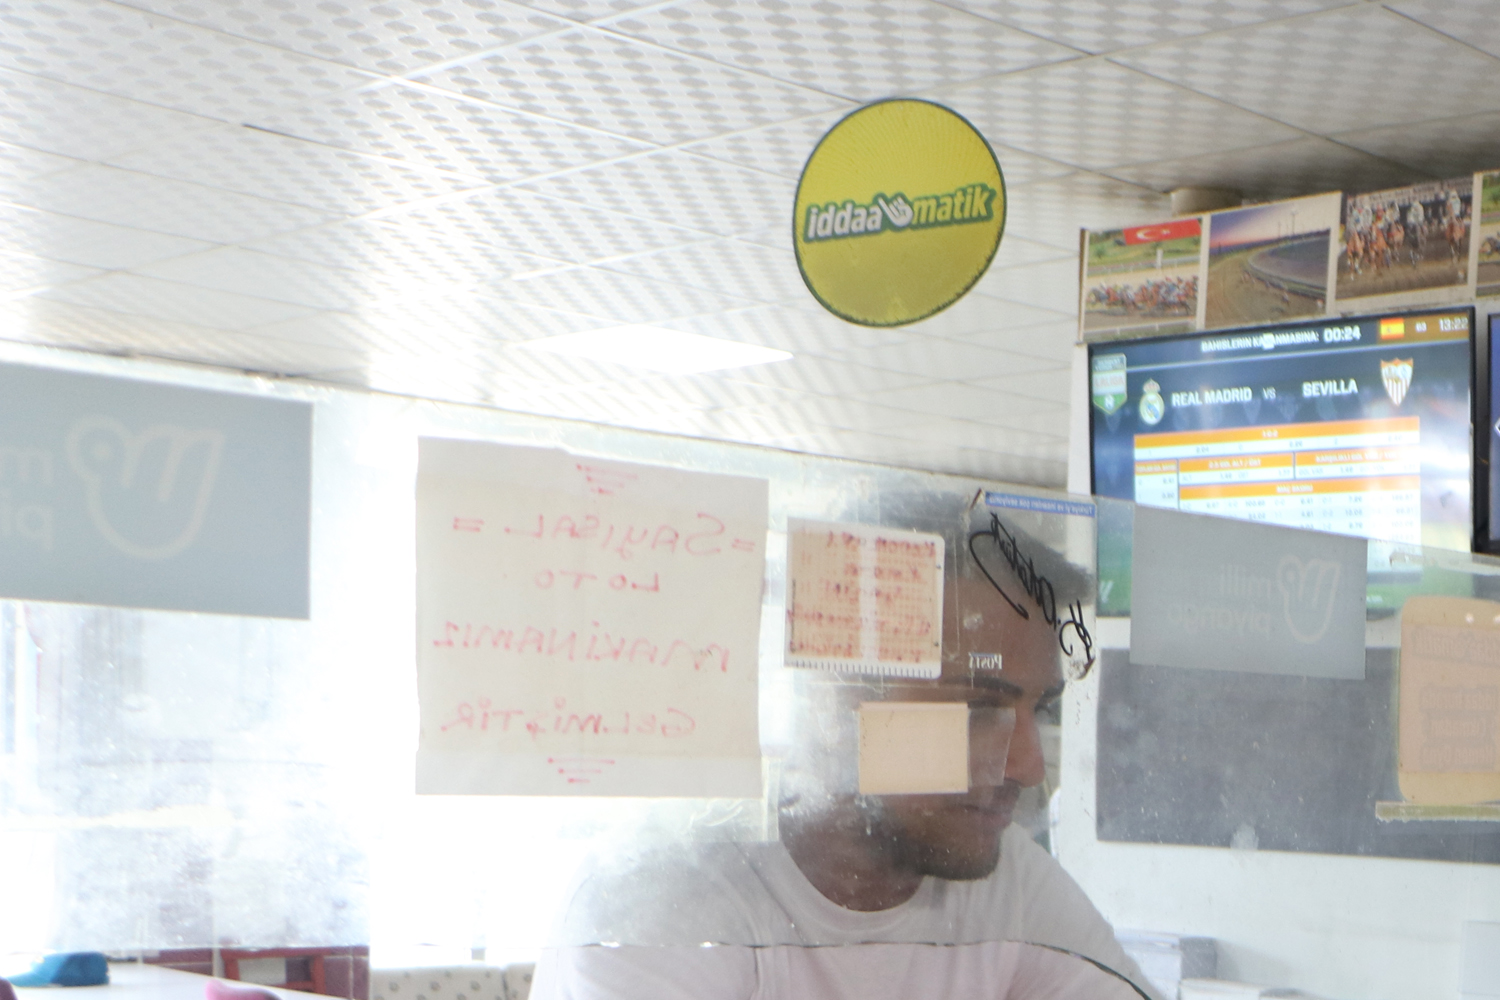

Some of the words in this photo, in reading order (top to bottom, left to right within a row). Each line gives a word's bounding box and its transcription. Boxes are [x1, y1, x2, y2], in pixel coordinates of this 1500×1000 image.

[807, 204, 883, 240] iddaa
[911, 185, 991, 224] matik
[1324, 326, 1361, 342] 00:24
[1172, 390, 1202, 407] REAL
[1204, 387, 1253, 405] MADRID
[1262, 387, 1277, 400] VS
[1302, 379, 1358, 397] SEVILLA
